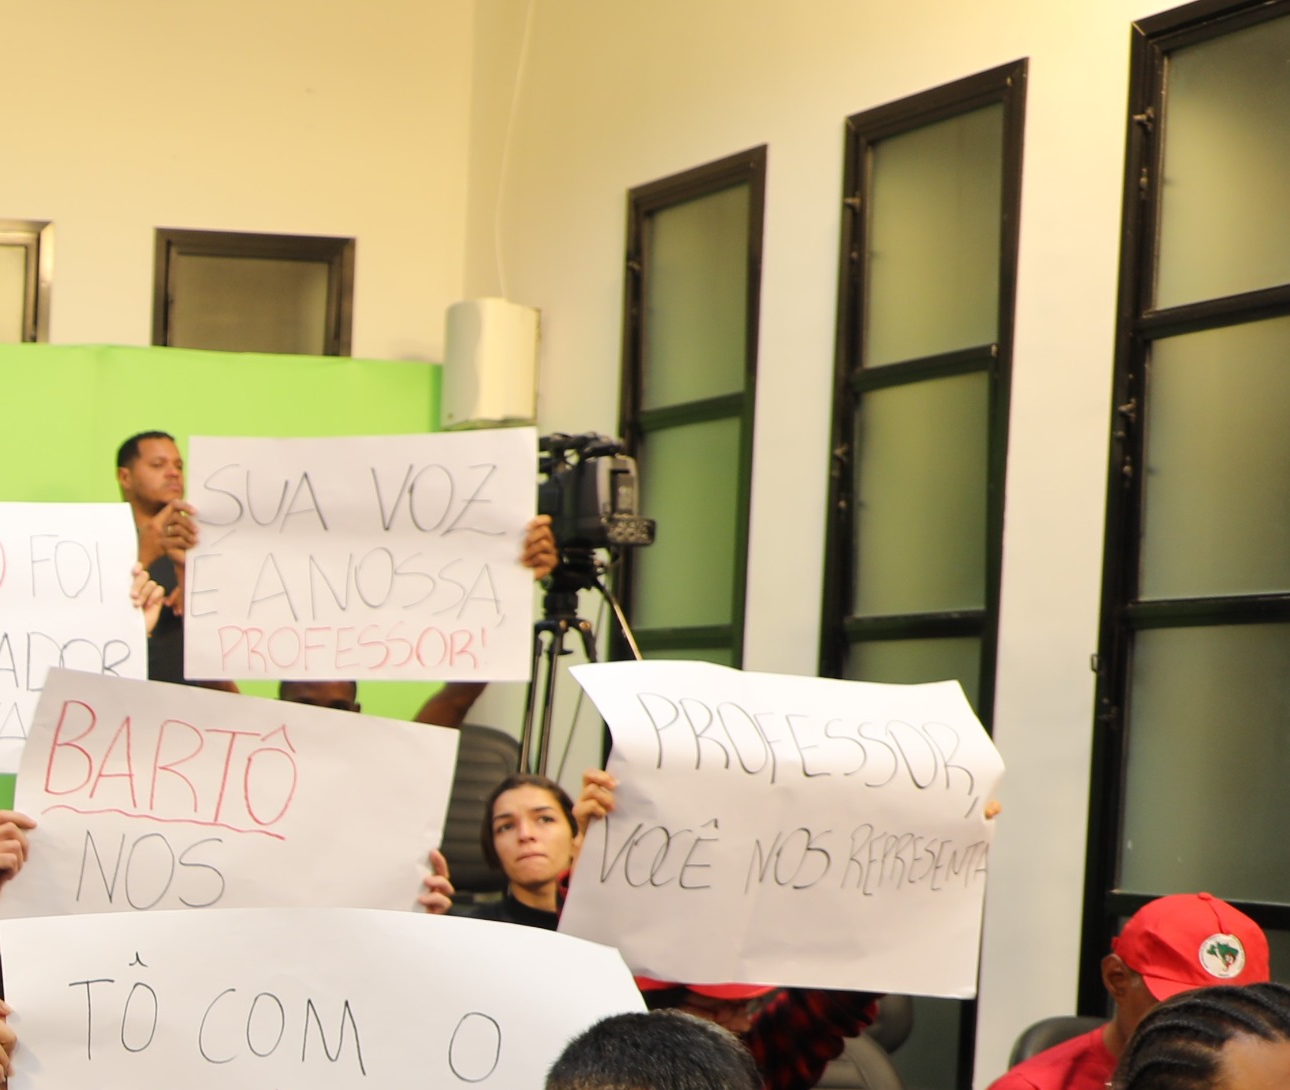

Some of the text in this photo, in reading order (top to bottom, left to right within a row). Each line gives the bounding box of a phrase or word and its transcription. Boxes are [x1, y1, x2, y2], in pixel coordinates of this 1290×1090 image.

[197, 463, 506, 537] SUA VOZ
[29, 532, 105, 605] FOI
[190, 529, 236, 618] É
[247, 552, 298, 621] A
[218, 621, 490, 673] PROFESSOR!
[42, 699, 299, 828] BARTÔ
[636, 692, 980, 819] PROFESSOR,
[76, 829, 226, 911] NOS
[599, 815, 720, 890] VOCÊ
[744, 827, 833, 895] NOS
[68, 952, 503, 1083] TÔ COM O
